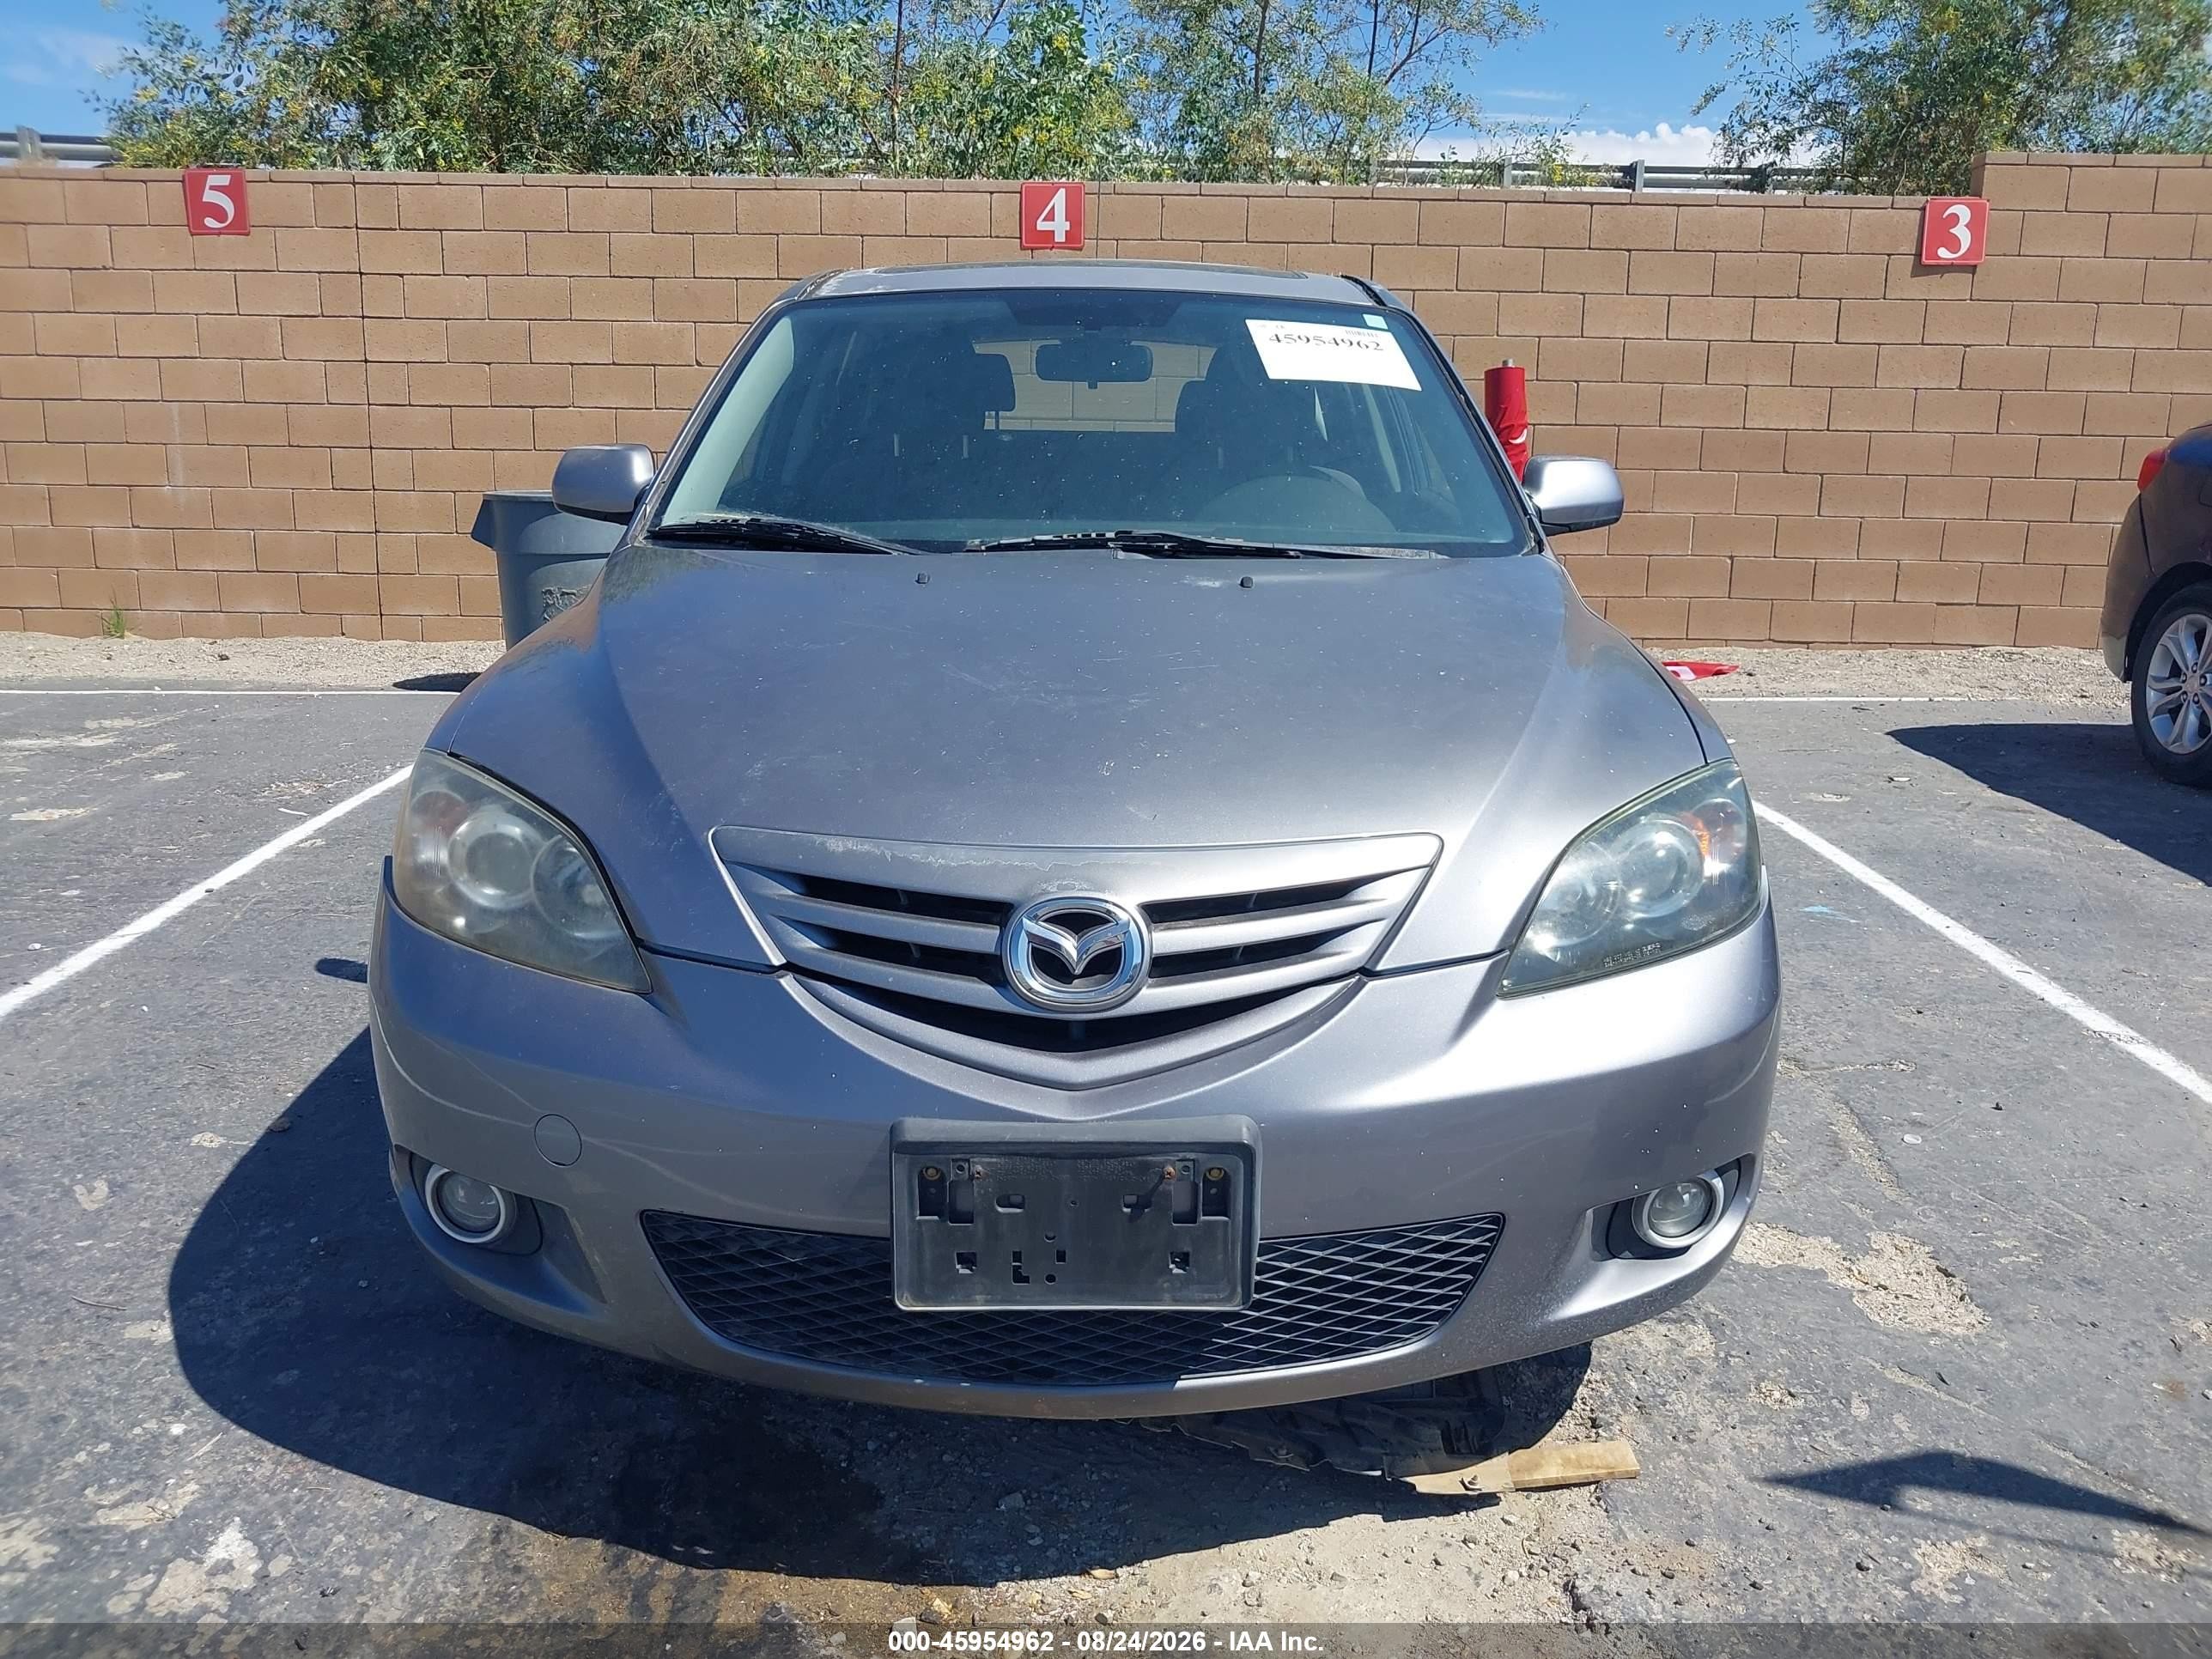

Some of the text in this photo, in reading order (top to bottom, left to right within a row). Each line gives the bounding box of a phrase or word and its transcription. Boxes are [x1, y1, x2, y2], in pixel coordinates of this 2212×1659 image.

[202, 174, 235, 228] 5
[1036, 187, 1071, 243] 4
[1936, 204, 1972, 259] 3
[1268, 333, 1384, 351] 45954962
